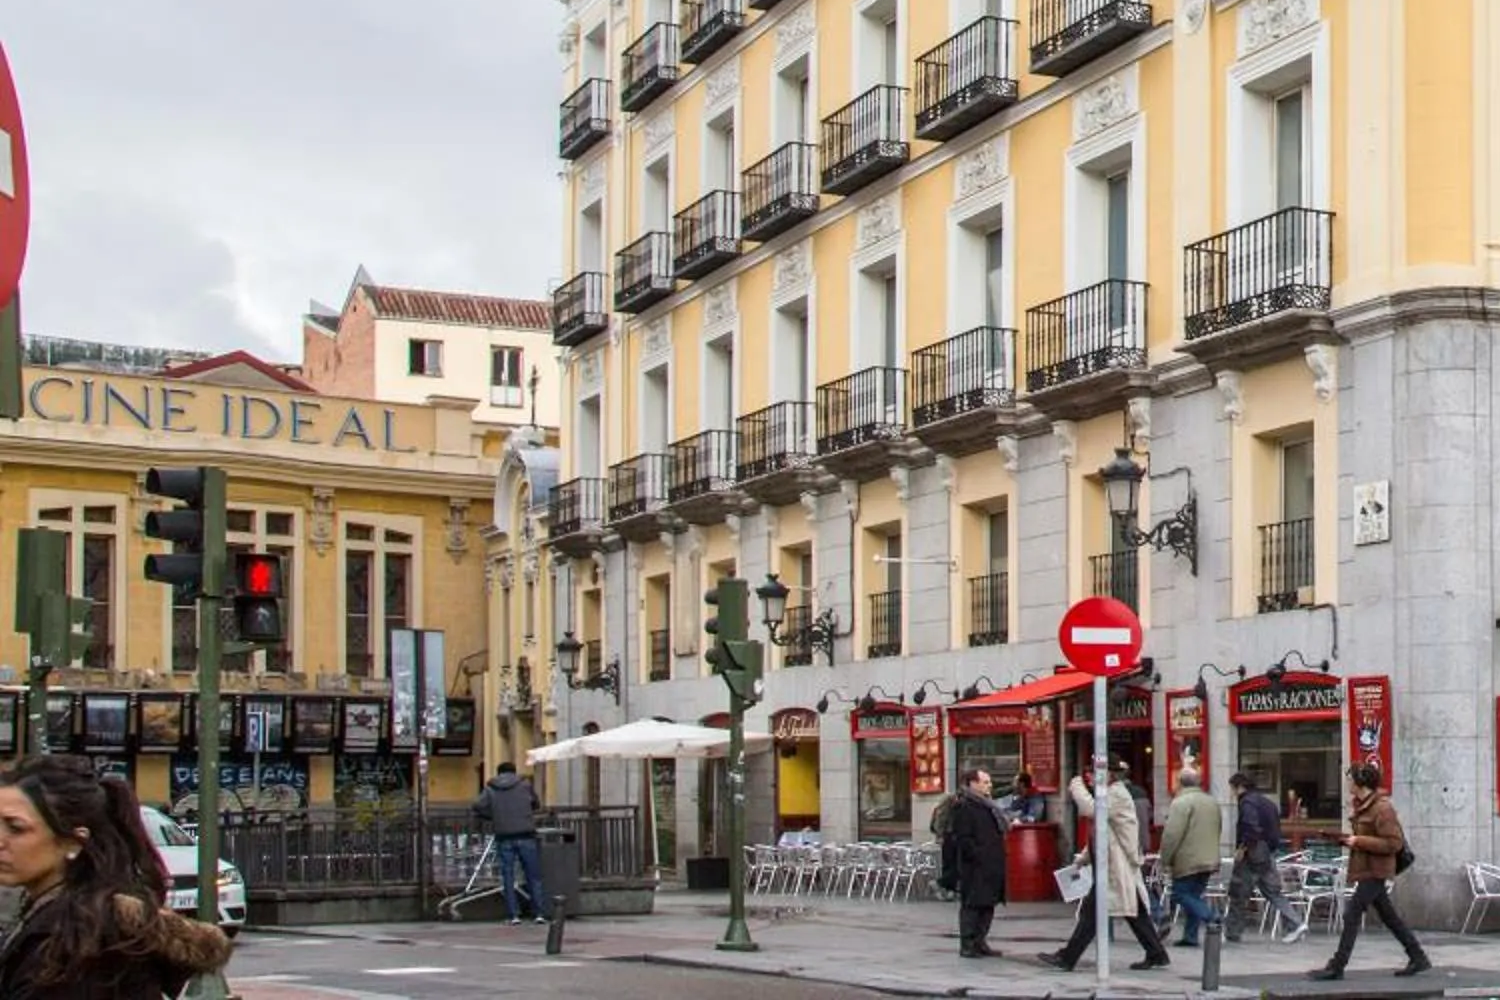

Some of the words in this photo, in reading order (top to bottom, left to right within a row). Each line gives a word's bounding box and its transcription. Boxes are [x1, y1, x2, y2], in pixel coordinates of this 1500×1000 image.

[29, 376, 198, 433] CINE
[222, 393, 418, 453] IDEAL
[1240, 692, 1273, 713] TAPAS
